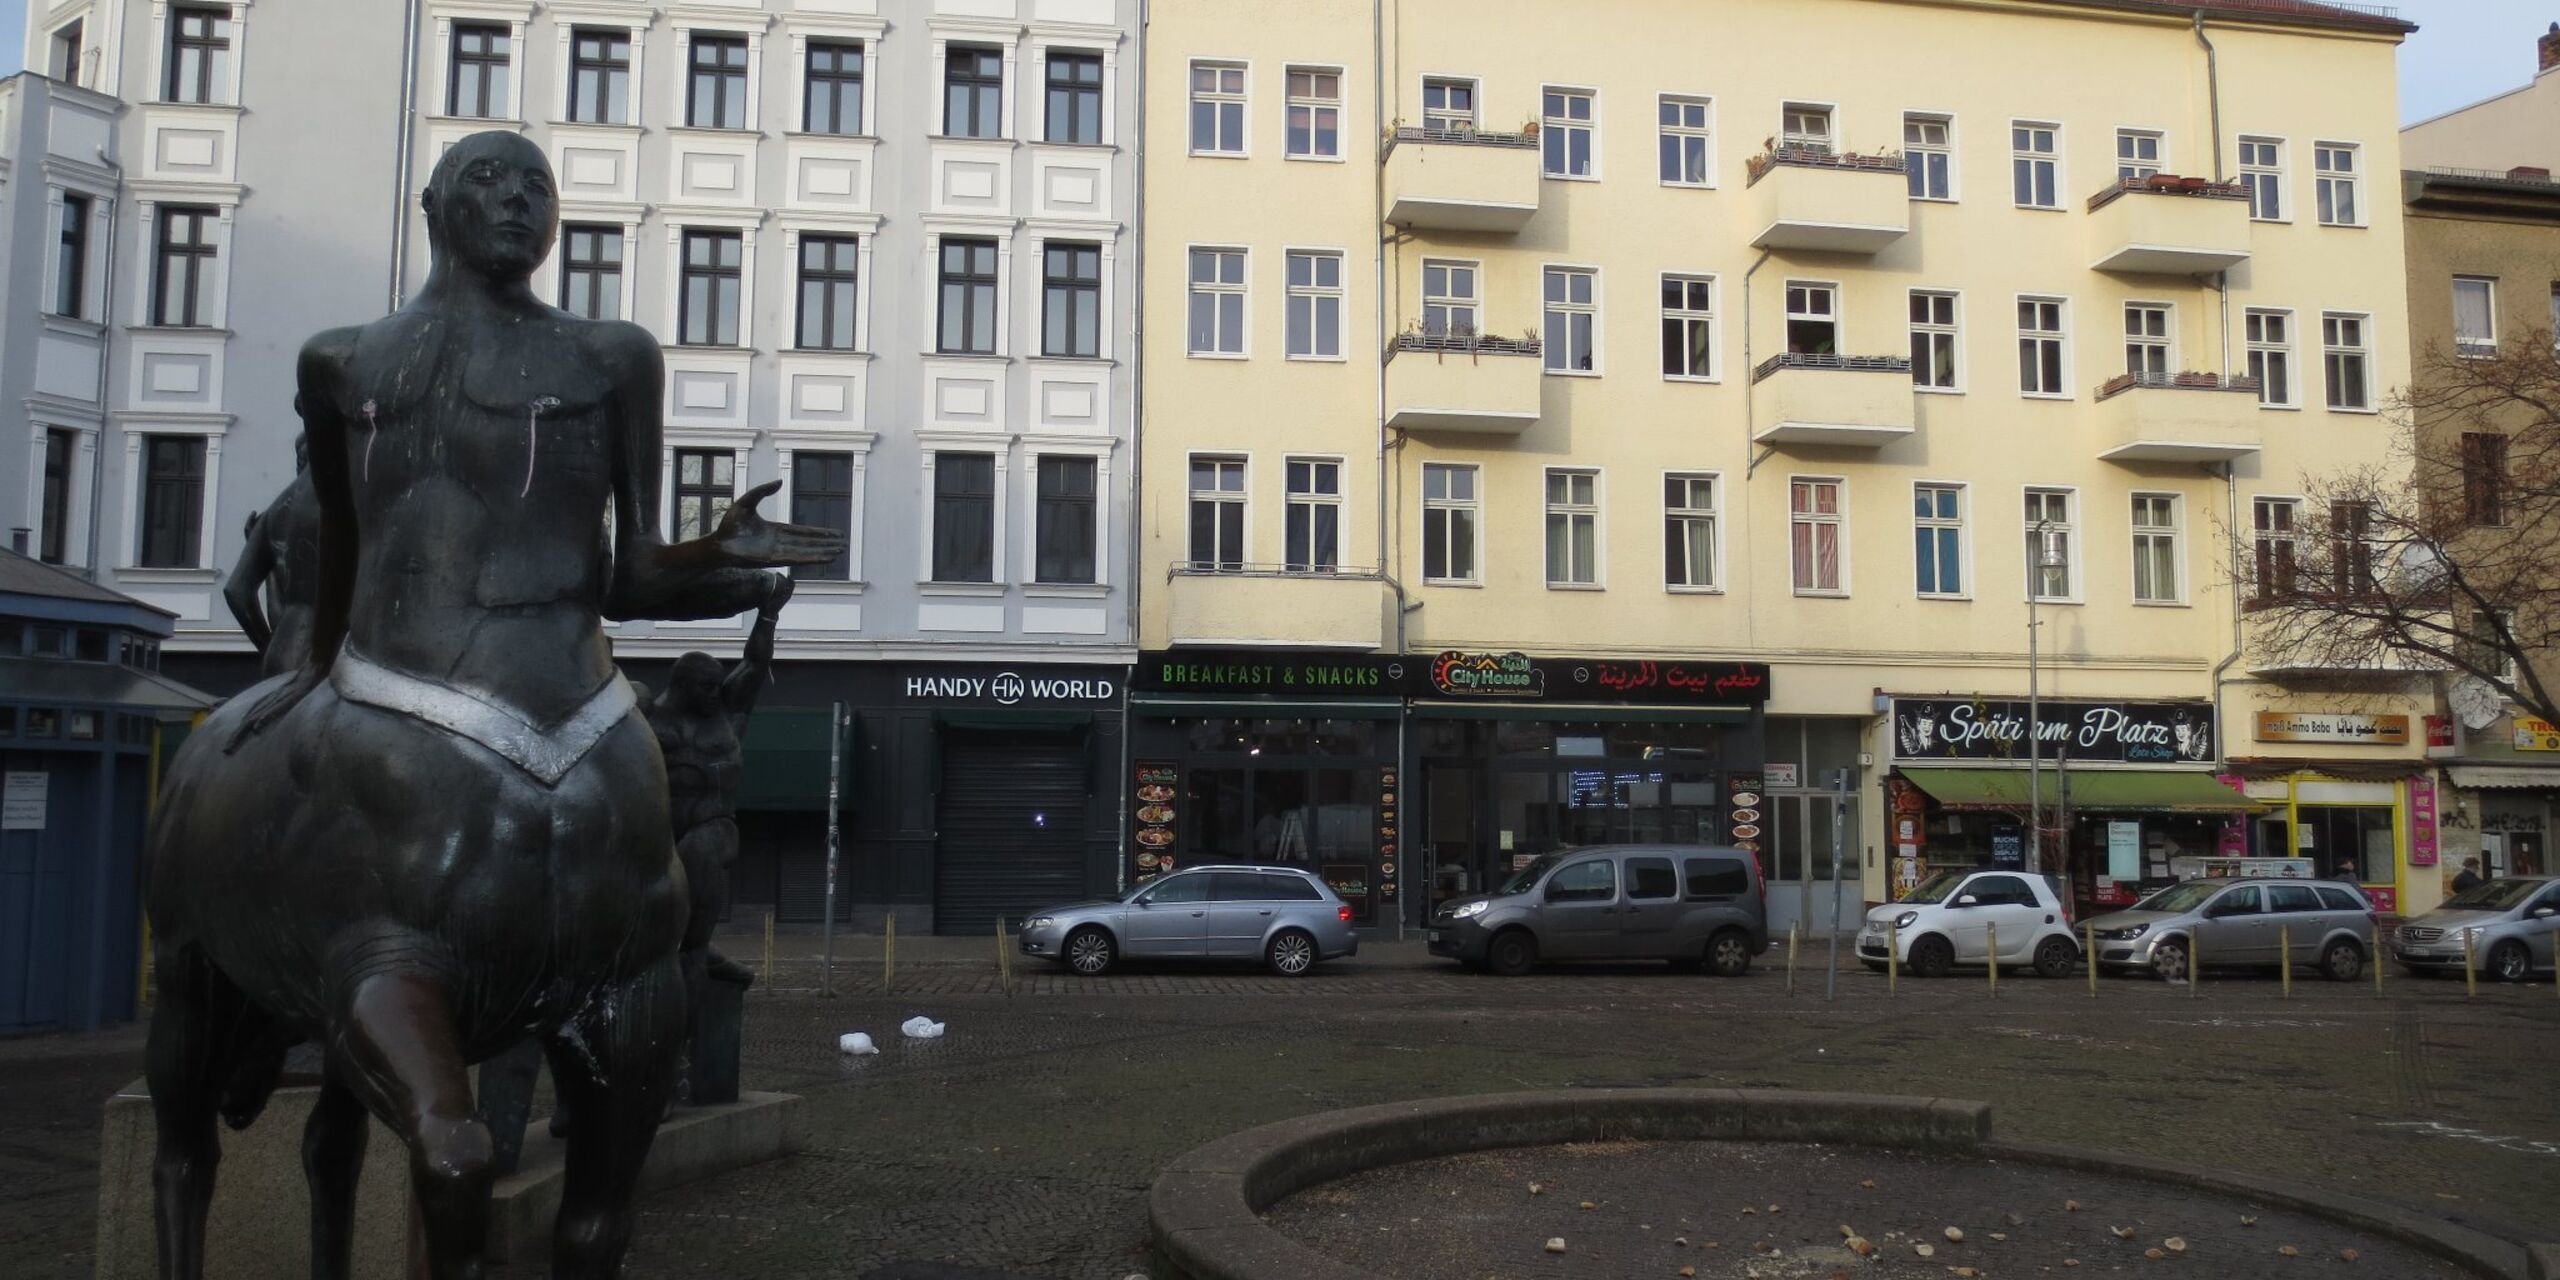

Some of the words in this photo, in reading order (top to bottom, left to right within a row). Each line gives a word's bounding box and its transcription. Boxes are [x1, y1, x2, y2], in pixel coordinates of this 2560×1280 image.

[1163, 664, 1273, 685] BREAKFAST
[1284, 666, 1295, 685] &
[1306, 666, 1379, 686] SNACKS
[1450, 669, 1480, 688] City
[1482, 669, 1530, 685] House
[1598, 660, 1658, 691] المدينة
[1666, 665, 1708, 692] بيت
[1714, 662, 1761, 697] مطعم
[906, 677, 986, 697] HANDY
[1030, 680, 1113, 699] WORLD
[1940, 704, 2024, 748] Späti
[2029, 719, 2071, 742] am
[2078, 708, 2169, 747] Platz
[2311, 720, 2331, 733] Baba
